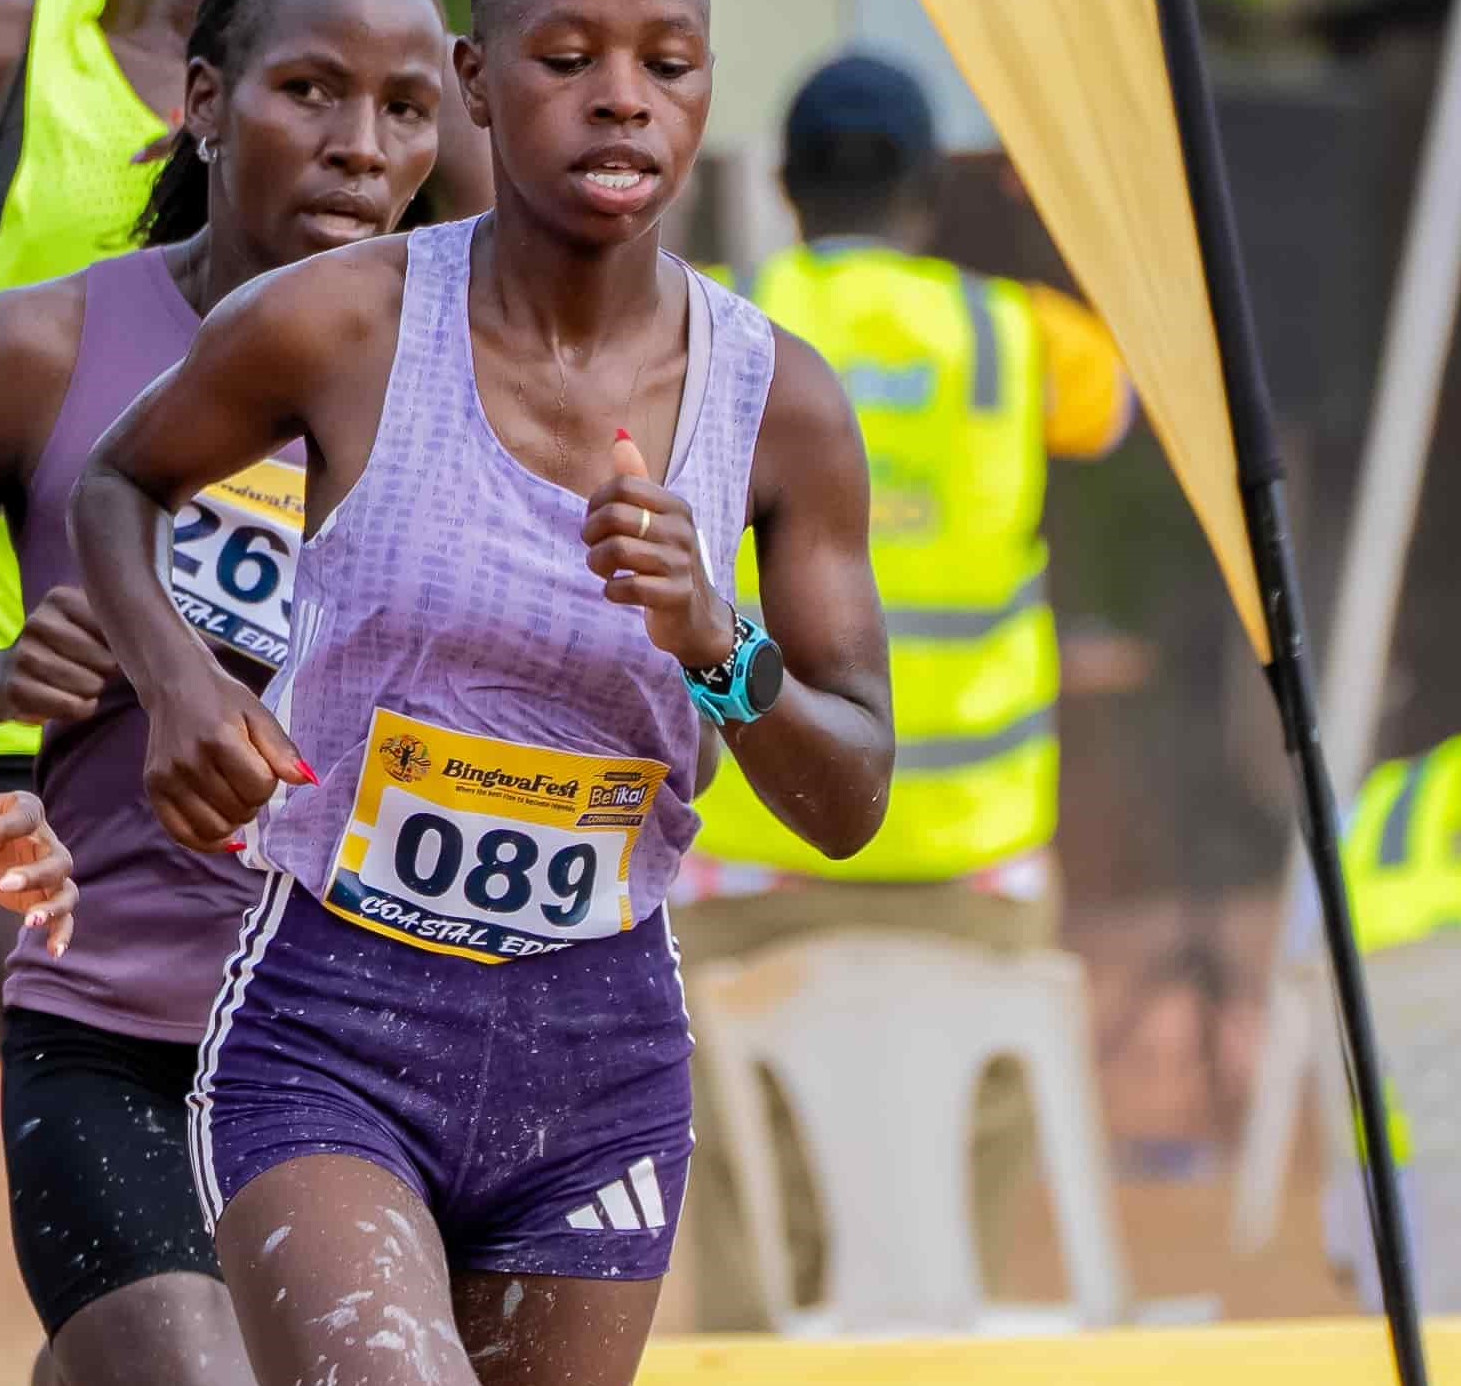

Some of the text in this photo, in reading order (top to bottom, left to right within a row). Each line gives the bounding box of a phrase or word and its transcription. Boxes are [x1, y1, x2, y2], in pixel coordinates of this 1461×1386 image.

[173, 502, 291, 623] 26
[442, 758, 579, 799] BingwaFest
[394, 812, 598, 928] 089
[360, 896, 488, 945] COASTAL
